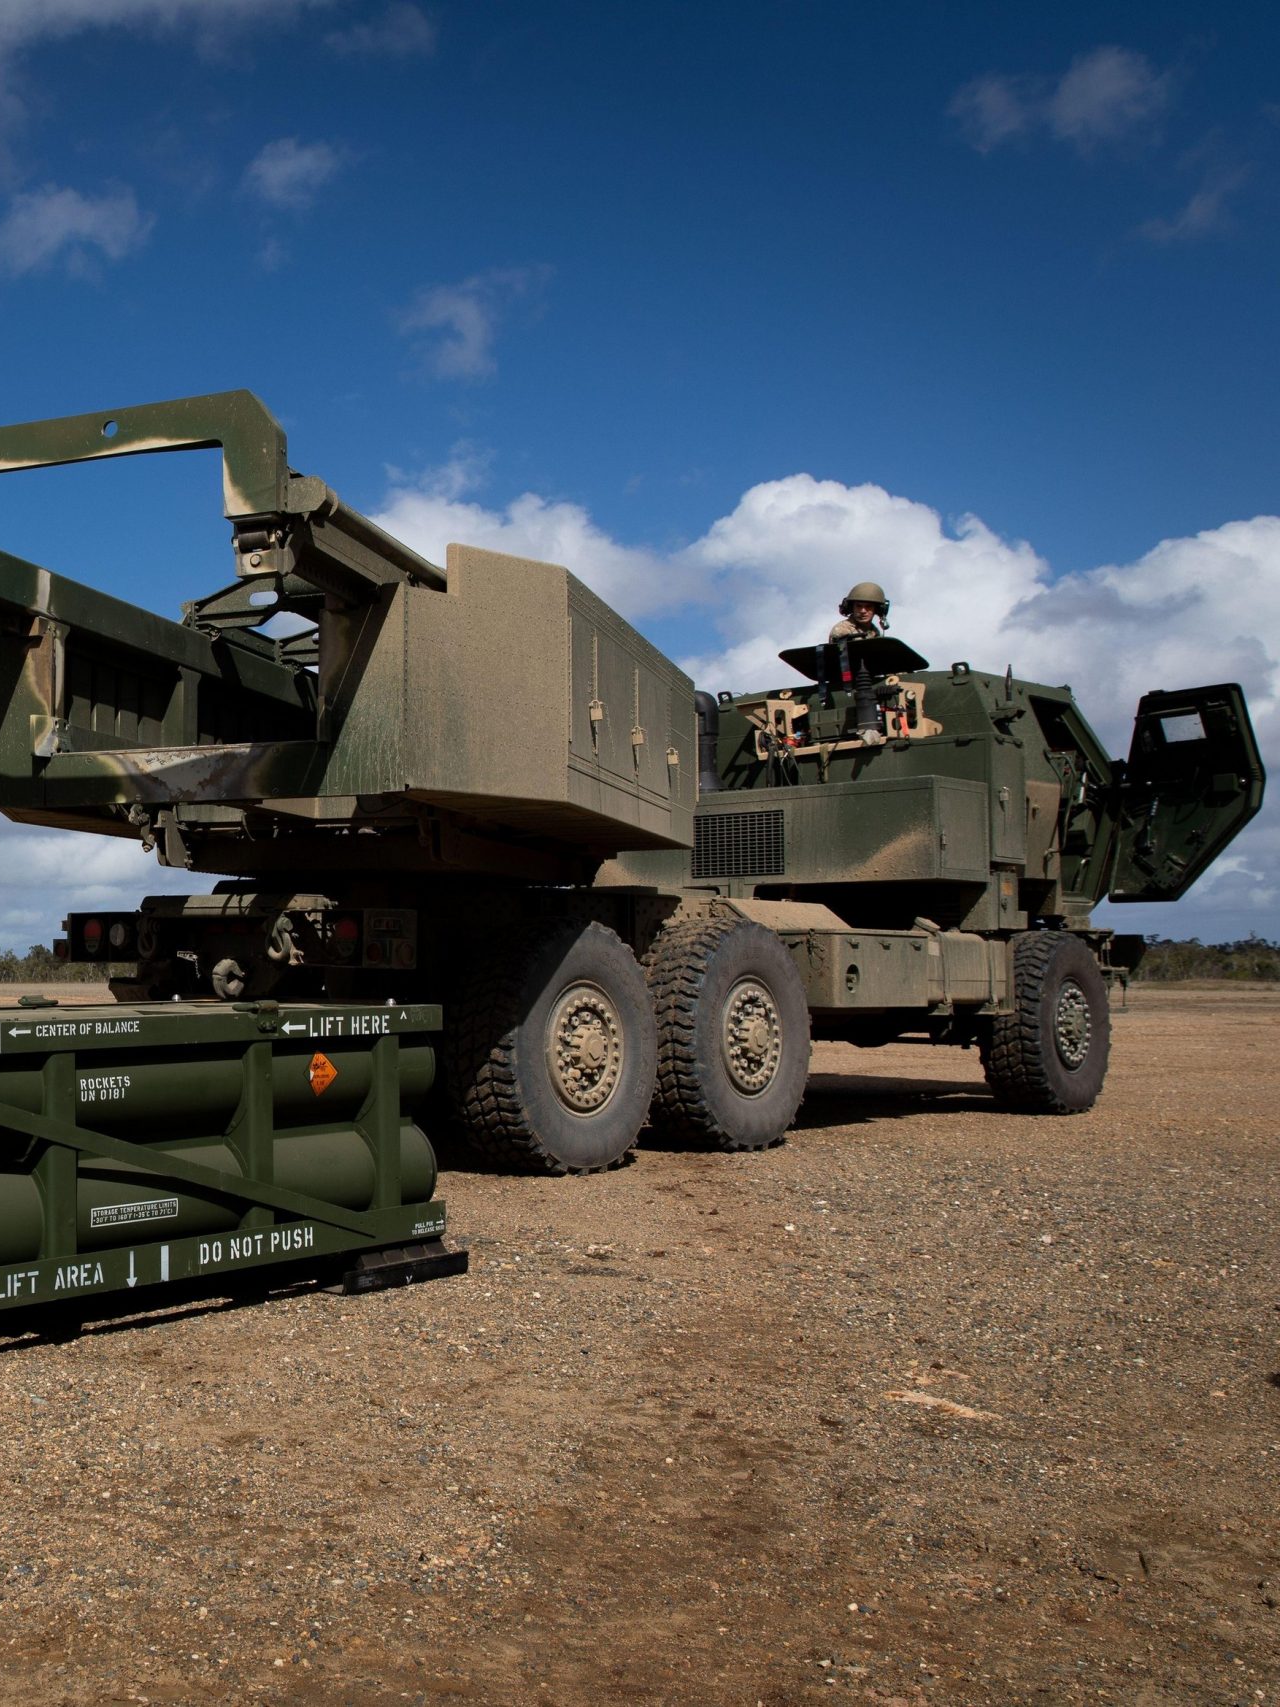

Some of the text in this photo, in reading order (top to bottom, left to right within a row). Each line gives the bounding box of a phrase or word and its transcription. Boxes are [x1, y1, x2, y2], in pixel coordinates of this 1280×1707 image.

[35, 1021, 140, 1037] CENTER OF BALANCE
[310, 1015, 390, 1037] LIFT HERE
[80, 1075, 131, 1090] ROCKETS
[81, 1087, 125, 1102] UN 0181
[93, 1201, 177, 1217] STORAGE TEMPERATURE LIMITS
[200, 1226, 313, 1265] DO NOT PUSH
[54, 1262, 104, 1291] AREA
